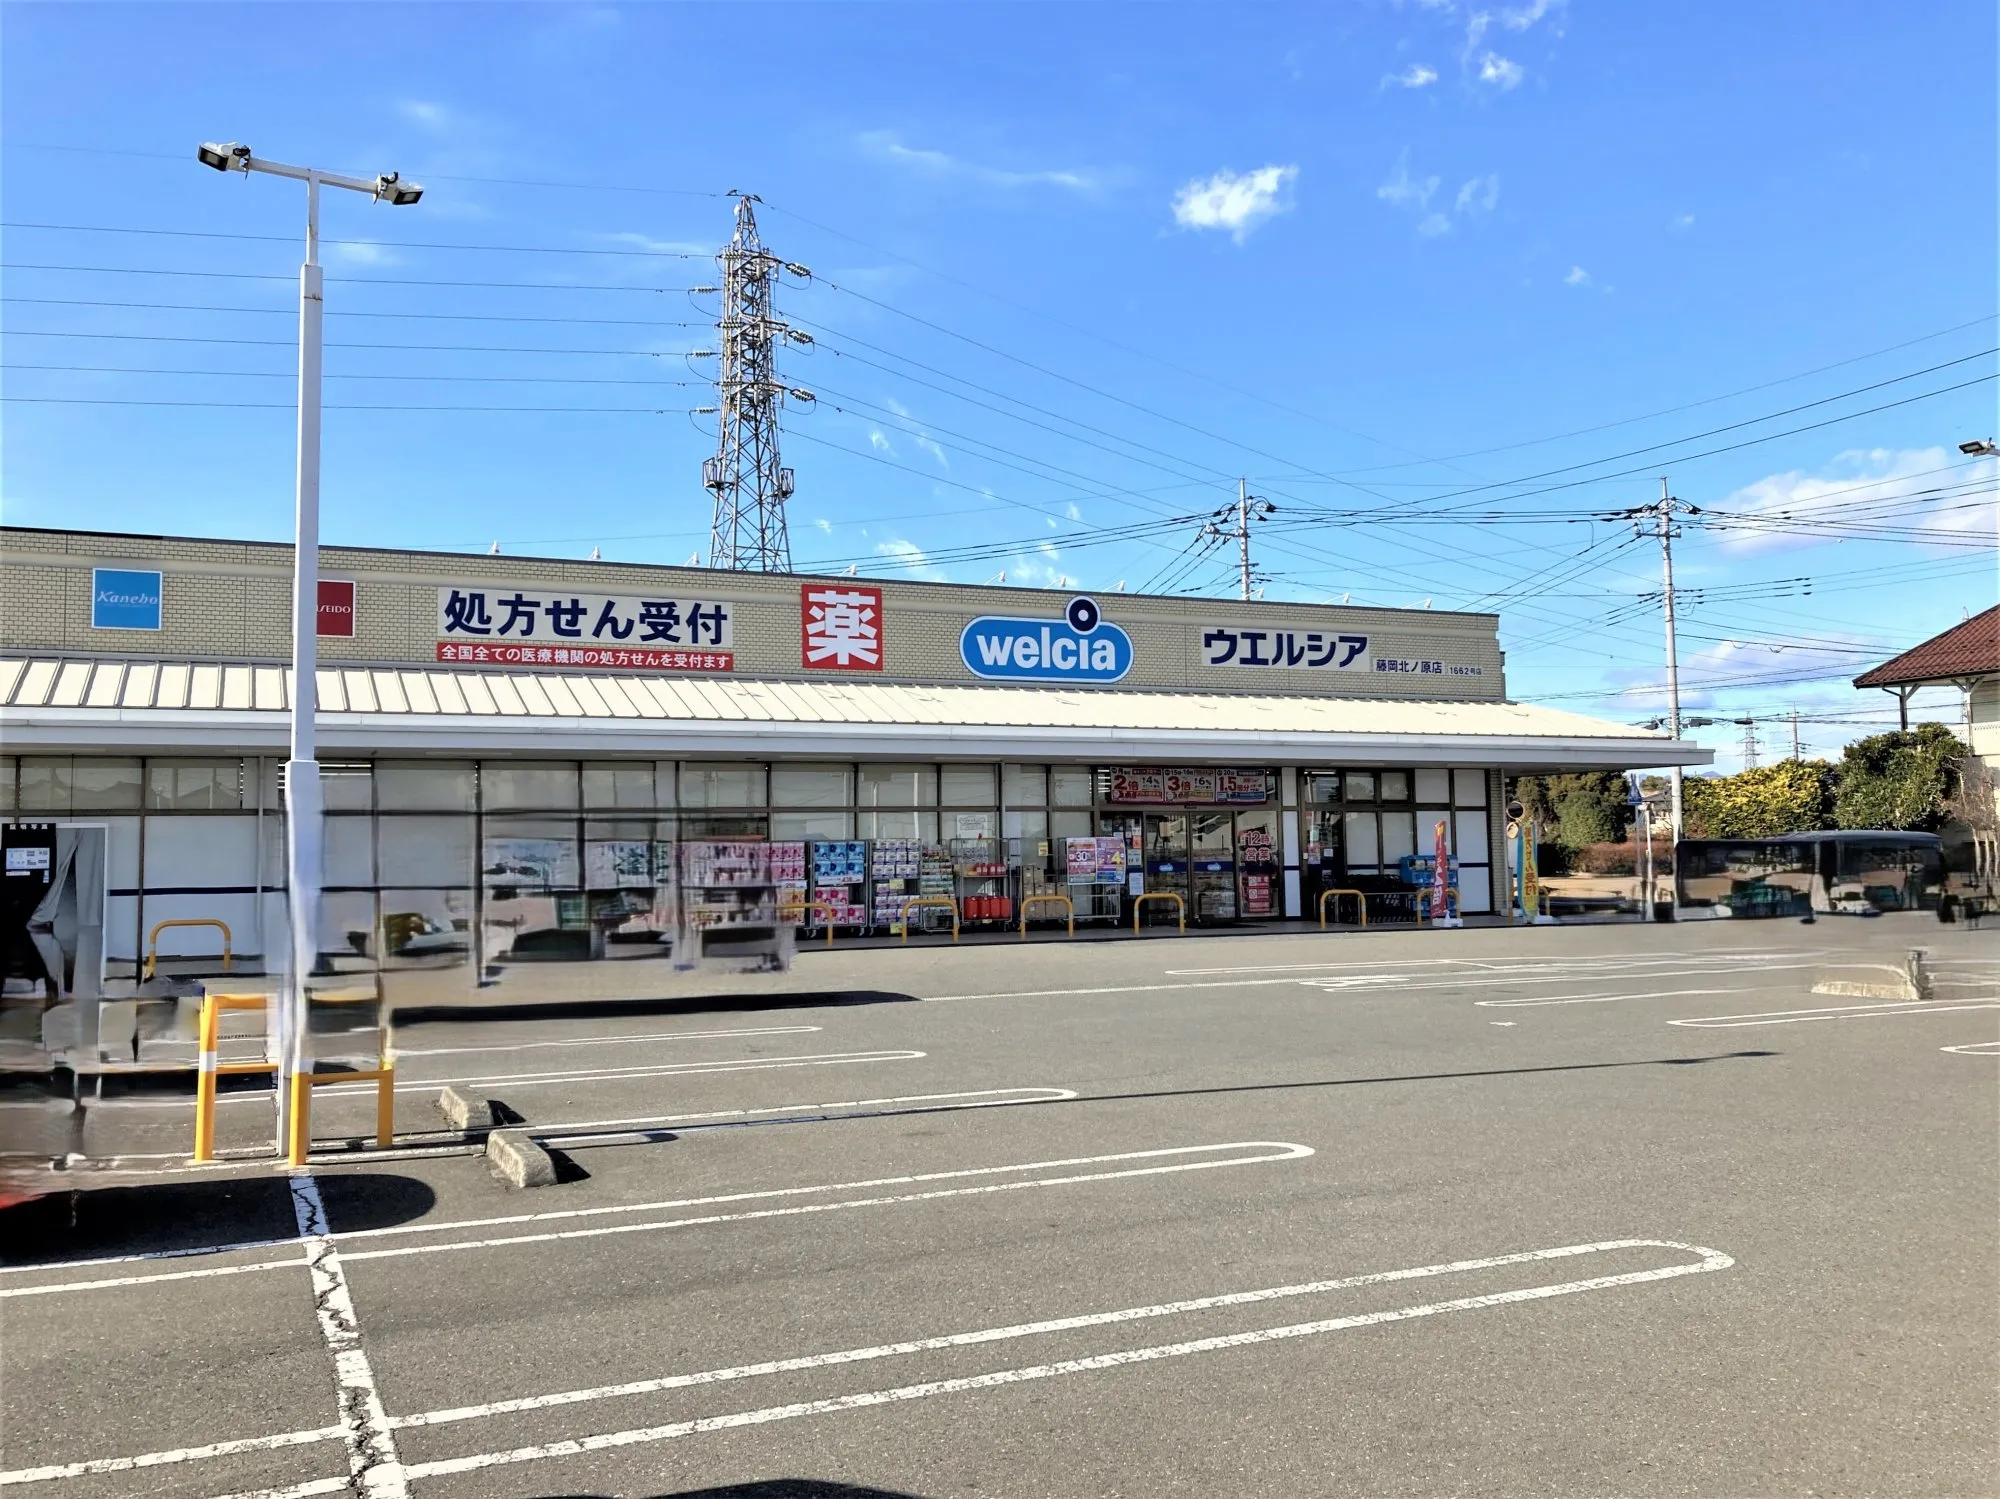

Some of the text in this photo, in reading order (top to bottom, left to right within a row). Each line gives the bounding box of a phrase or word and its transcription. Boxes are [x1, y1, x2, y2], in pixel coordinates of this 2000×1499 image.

[444, 590, 728, 645] 処方せん受付
[805, 590, 880, 665] 薬
[441, 645, 730, 669] 全国全ての医療機関の処方せんを受付ます
[976, 626, 1116, 671] welcia
[1203, 629, 1368, 668] ウエルシア
[1375, 659, 1443, 674] 藤岡北ノ原店
